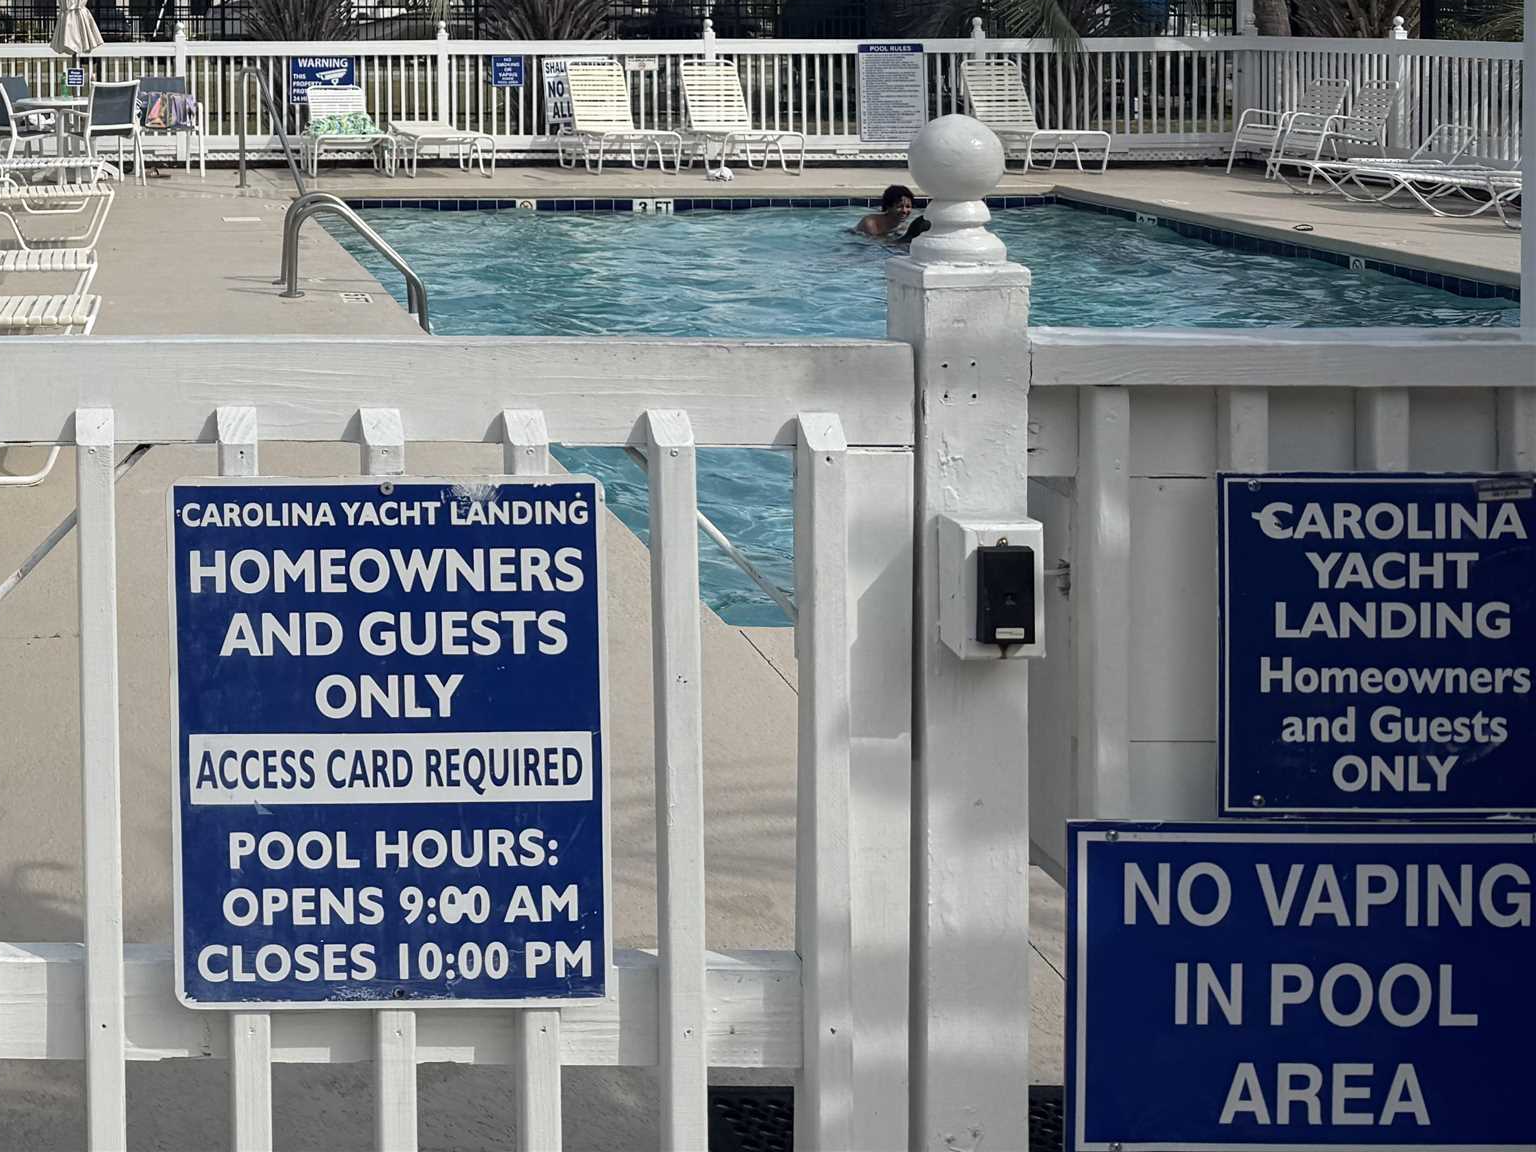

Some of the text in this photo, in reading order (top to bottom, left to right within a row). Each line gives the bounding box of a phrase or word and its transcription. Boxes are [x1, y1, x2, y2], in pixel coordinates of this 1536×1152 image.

[298, 57, 348, 68] WARNING
[547, 80, 565, 98] NO
[655, 201, 672, 212] FT
[182, 500, 589, 528] CAROLINA YACHT LANDING
[1258, 501, 1528, 540] CAROLINA
[189, 547, 585, 594] HOMEOWNERS
[1304, 551, 1480, 589] YACHT
[219, 610, 568, 656] AND GUESTS
[1275, 601, 1512, 639] LANDING
[1260, 656, 1532, 694] Homeowners
[314, 673, 464, 719] ONLY
[1281, 705, 1509, 744] and Guests
[196, 747, 584, 795] ACCESS CARD REQUIRED
[1332, 755, 1460, 792] ONLY
[228, 828, 559, 870] POOL HOURS:
[222, 884, 579, 927] OPENS 9:00 AM
[1123, 861, 1533, 928] NO VAPING
[197, 940, 592, 983] CLOSES 10:00 PM
[1174, 962, 1479, 1028] IN POOL
[1218, 1062, 1432, 1126] AREA
